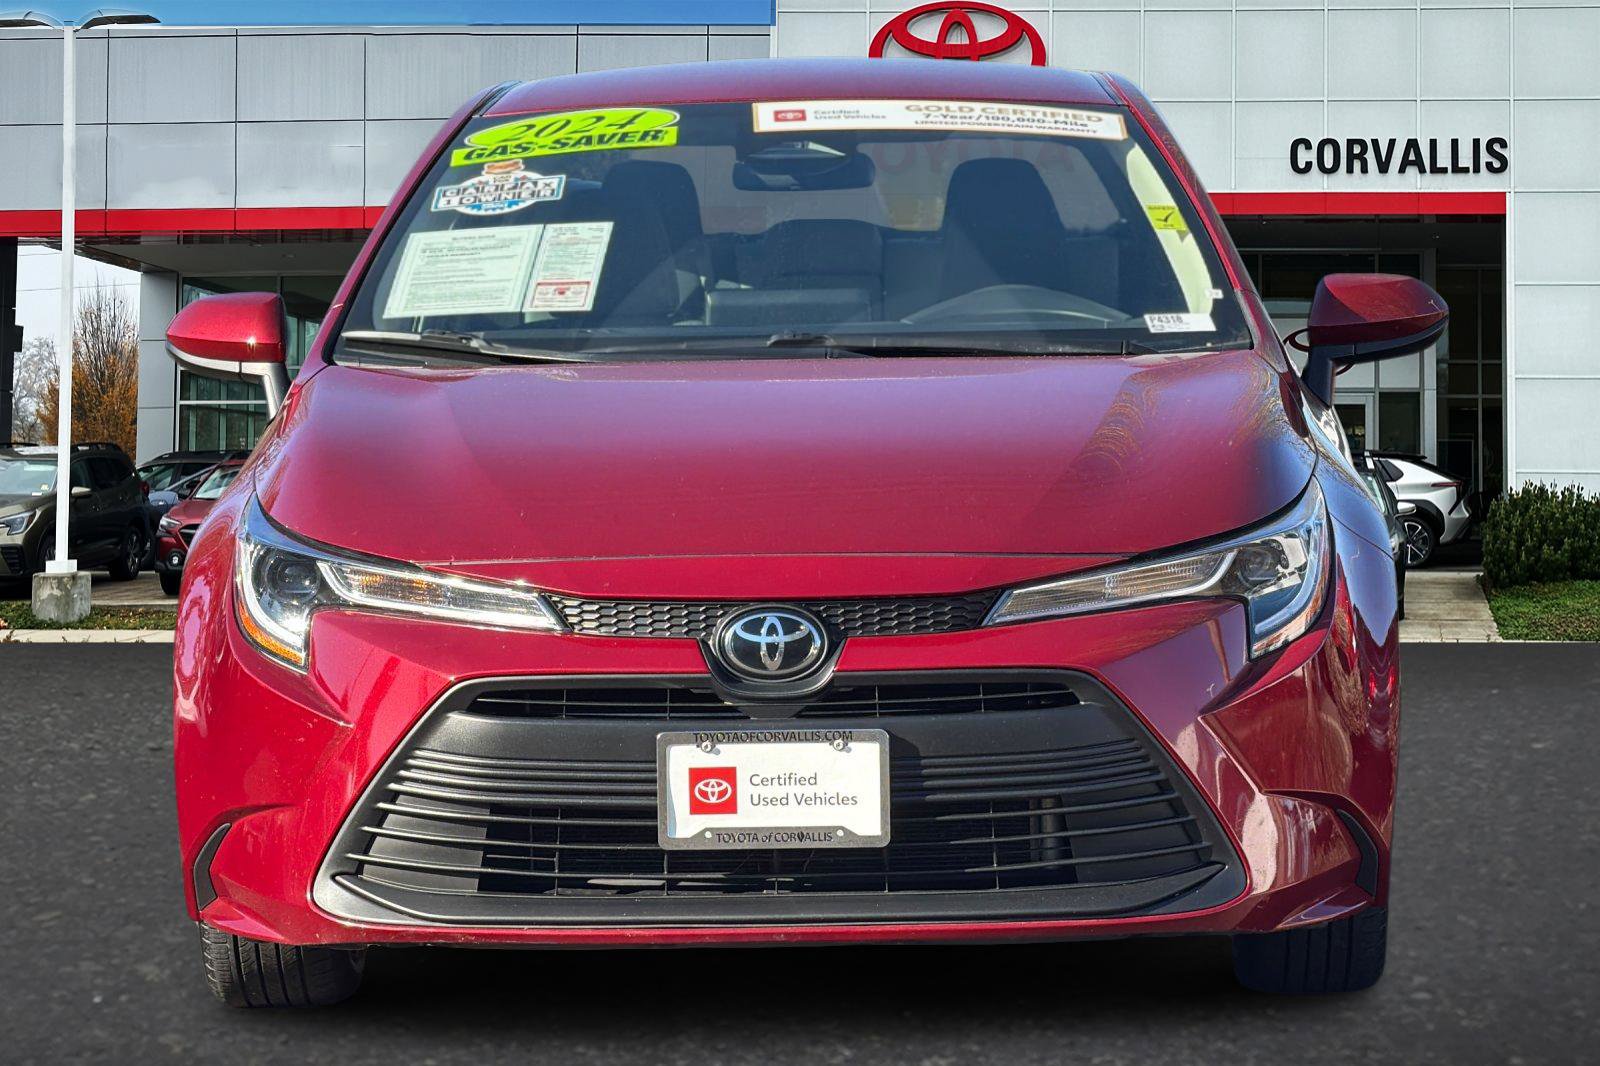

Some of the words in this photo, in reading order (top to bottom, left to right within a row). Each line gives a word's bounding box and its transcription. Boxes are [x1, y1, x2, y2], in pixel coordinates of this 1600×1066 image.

[904, 104, 975, 113] GOLD
[979, 106, 1103, 123] CERTIFIED
[503, 111, 648, 142] 2024
[1289, 137, 1509, 174] CORVALLIS
[443, 180, 554, 198] CARFAX
[692, 730, 853, 744] TOYOTAOFCORVALLIS.COM
[749, 772, 818, 787] Certified
[749, 793, 789, 807] Used
[793, 792, 858, 807] Vehicles
[715, 832, 759, 844] TOYOTA
[761, 832, 774, 844] of
[774, 832, 833, 843] CORVALLIS
